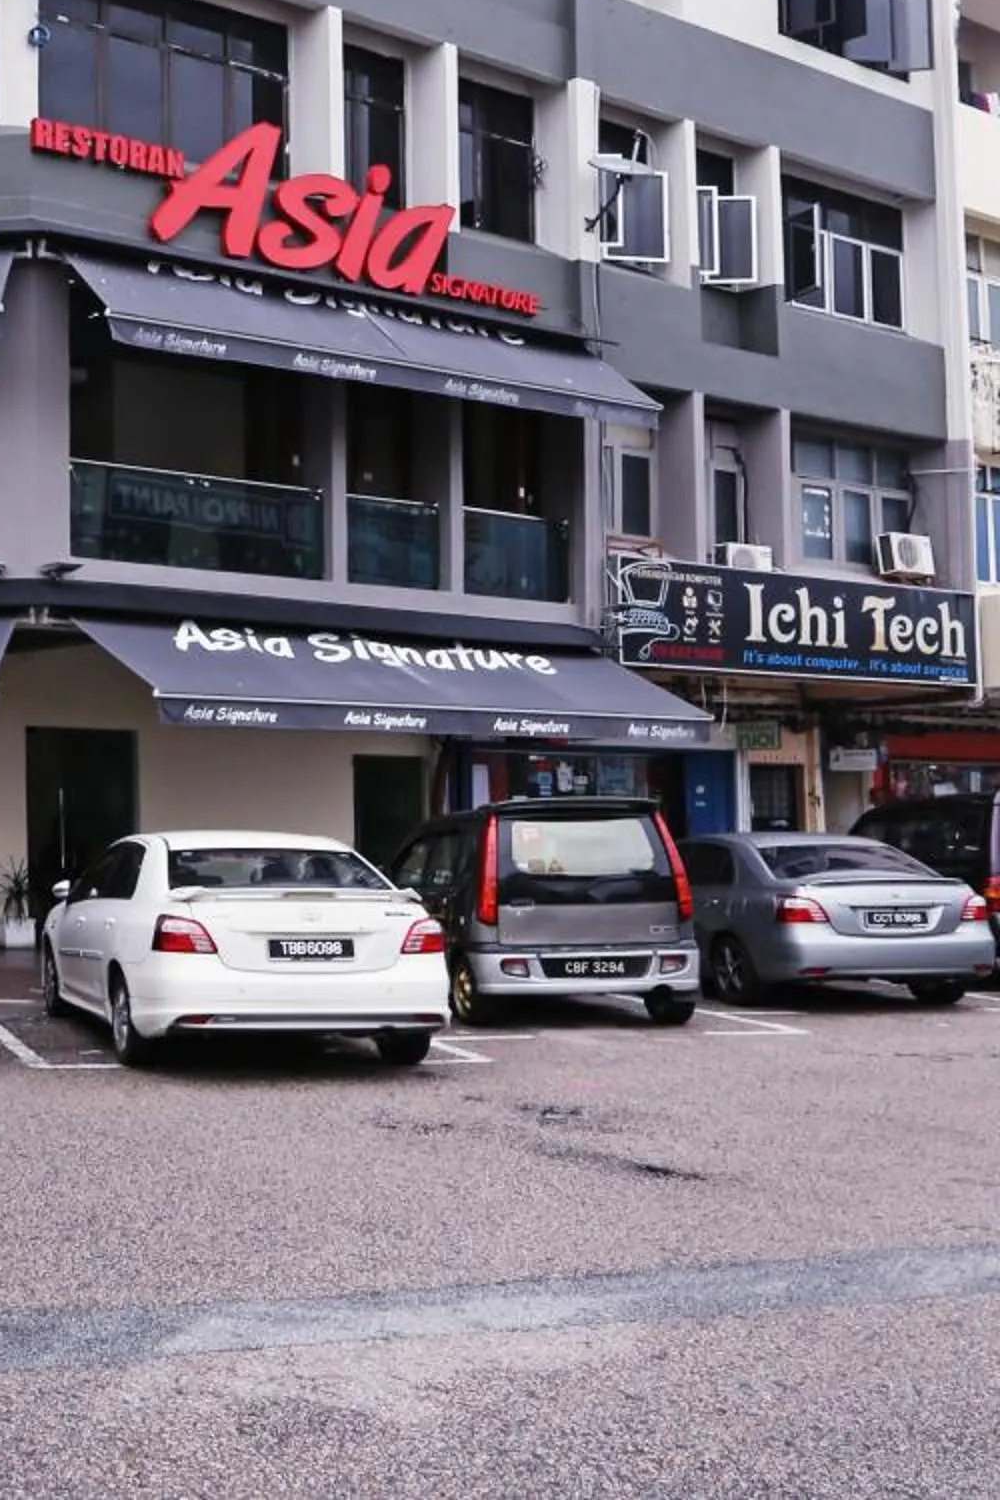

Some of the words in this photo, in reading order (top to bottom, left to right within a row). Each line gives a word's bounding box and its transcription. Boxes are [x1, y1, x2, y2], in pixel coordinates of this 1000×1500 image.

[30, 118, 186, 180] RESTORAN
[430, 272, 541, 316] SIGNATURE
[743, 582, 848, 649] Ichi
[861, 595, 967, 658] Tech
[173, 620, 295, 659] Asia
[307, 632, 557, 676] Signature
[766, 653, 802, 667] about
[890, 661, 921, 674] about
[183, 704, 213, 721] Asia
[215, 707, 279, 725] Signature
[344, 711, 371, 727] Asia
[372, 714, 427, 730] Signature
[493, 717, 520, 733] Asia
[520, 721, 570, 736] Signature
[565, 961, 589, 973] CBF
[592, 961, 625, 973] 3294
